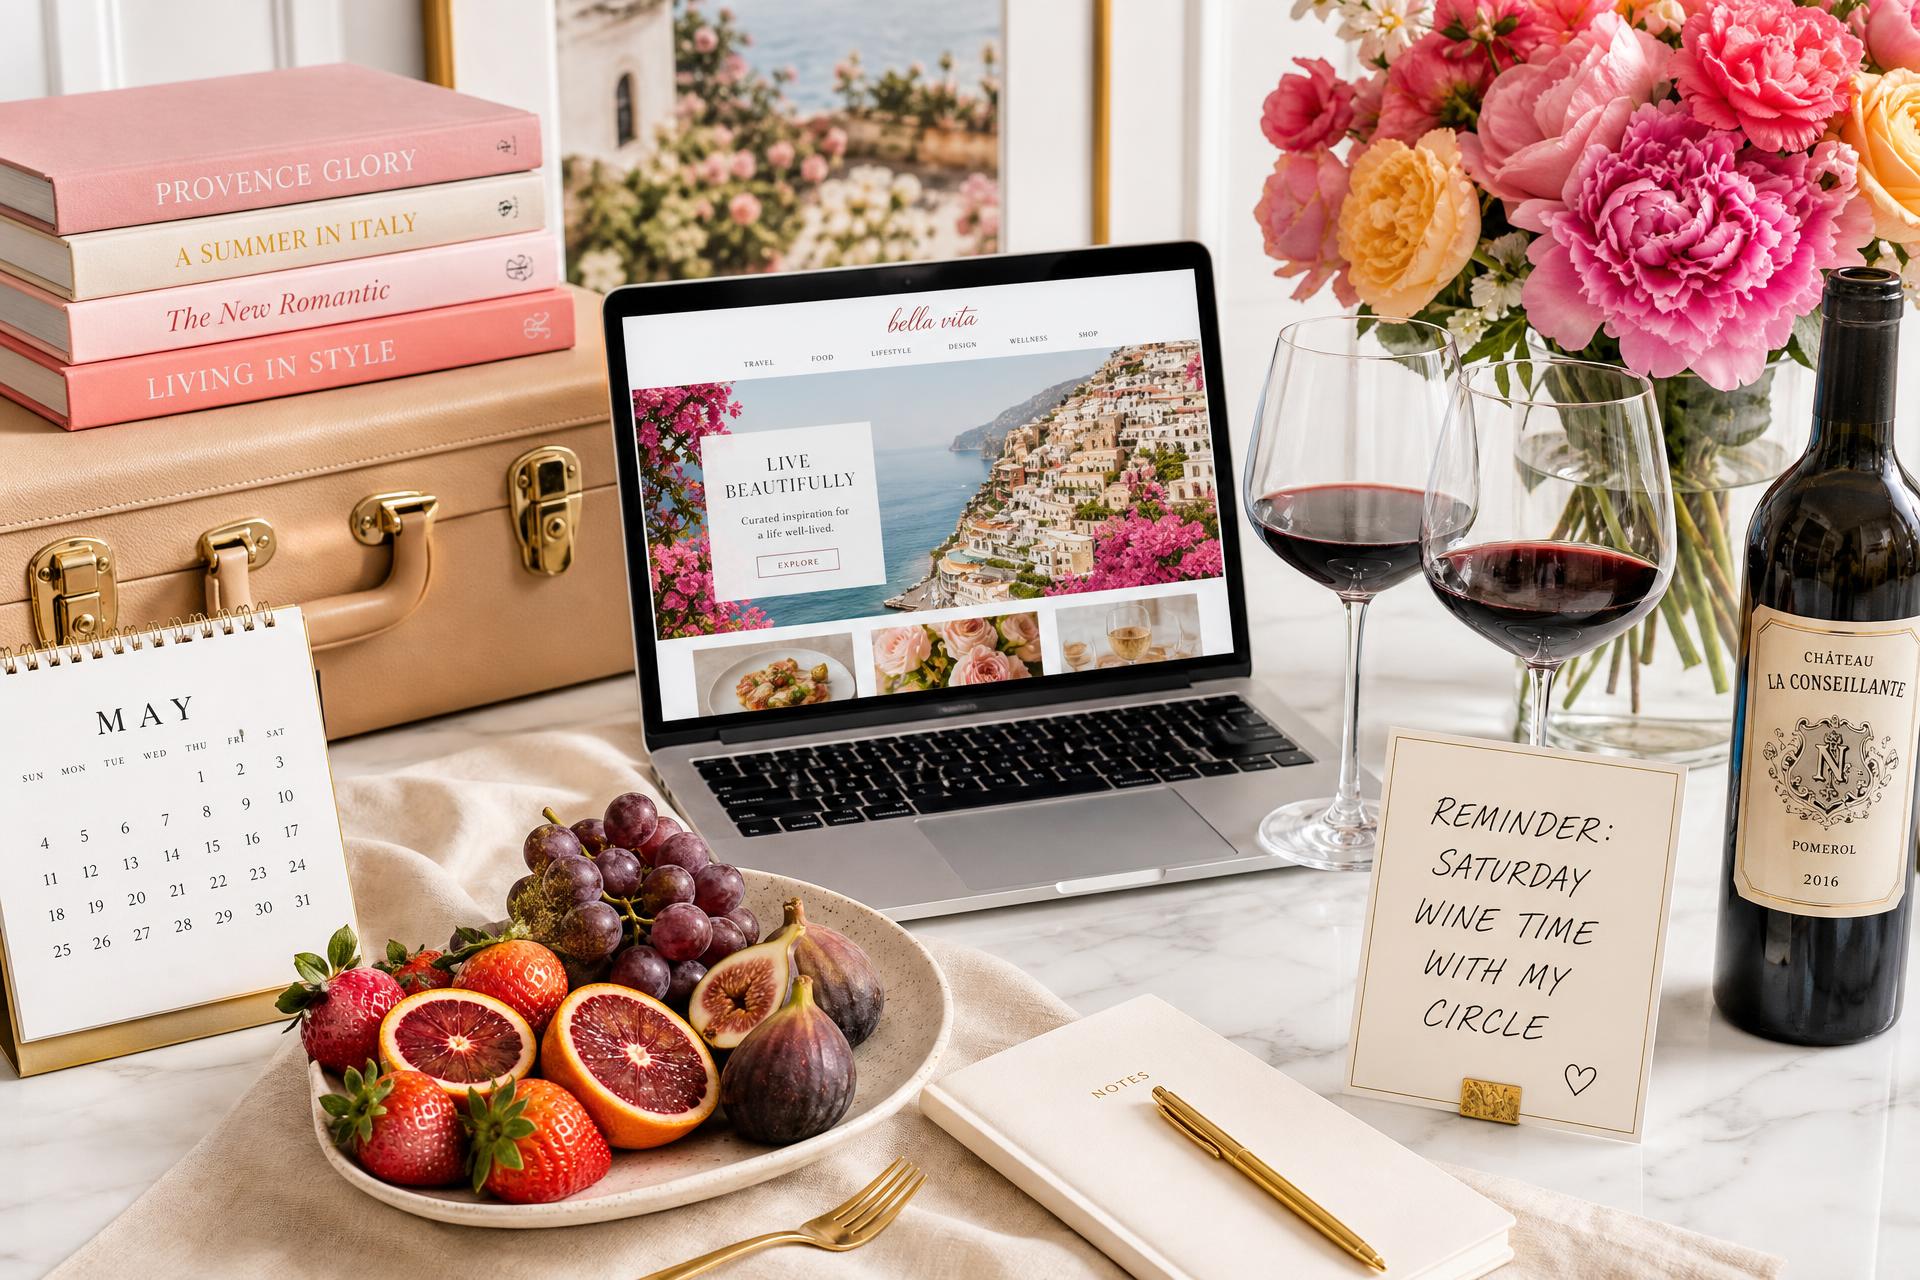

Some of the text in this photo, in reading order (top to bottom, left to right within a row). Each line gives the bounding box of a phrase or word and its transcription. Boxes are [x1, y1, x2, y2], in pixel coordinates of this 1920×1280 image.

[155, 148, 416, 207] PROVENCE GLORY
[175, 212, 416, 268] A SUMMER IN ITALY
[166, 279, 391, 333] The New Romantic
[887, 305, 978, 334] bella vita
[147, 339, 398, 401] LIVING IN STYLE
[743, 330, 1099, 368] TRAVEL FOOD LIFESTYLE DESIGN WELLNESS SHOP
[767, 453, 810, 472] LIVE
[725, 471, 855, 499] BEAUTIFULLY
[740, 506, 850, 526] Curated inspiration for
[757, 522, 835, 540] a life well-lived.
[777, 558, 819, 569] EXPLORE
[1767, 673, 1906, 699] LA CONSEILLANTE
[95, 695, 192, 736] MAY
[22, 727, 285, 783] SUN MON TUE WED THU FRI SAT
[197, 755, 284, 783] 1 2 3
[40, 789, 294, 850] 4 5 6 7 8 9 10
[1430, 796, 1614, 844] REMINDER:
[43, 823, 299, 887] 11 12 13 14 15 16 17
[1792, 839, 1857, 855] POMEROL
[48, 858, 306, 923] 18 19 20 21 22 23 24
[1431, 848, 1592, 898] SATURDAY
[1803, 873, 1839, 888] 2016
[53, 893, 311, 959] 25 26 27 28 29 30 31
[1414, 897, 1600, 946] WINE TIME
[1424, 949, 1573, 997] WITH MY
[1423, 998, 1550, 1041] CIRCLE
[1091, 1071, 1150, 1099] NOTES
